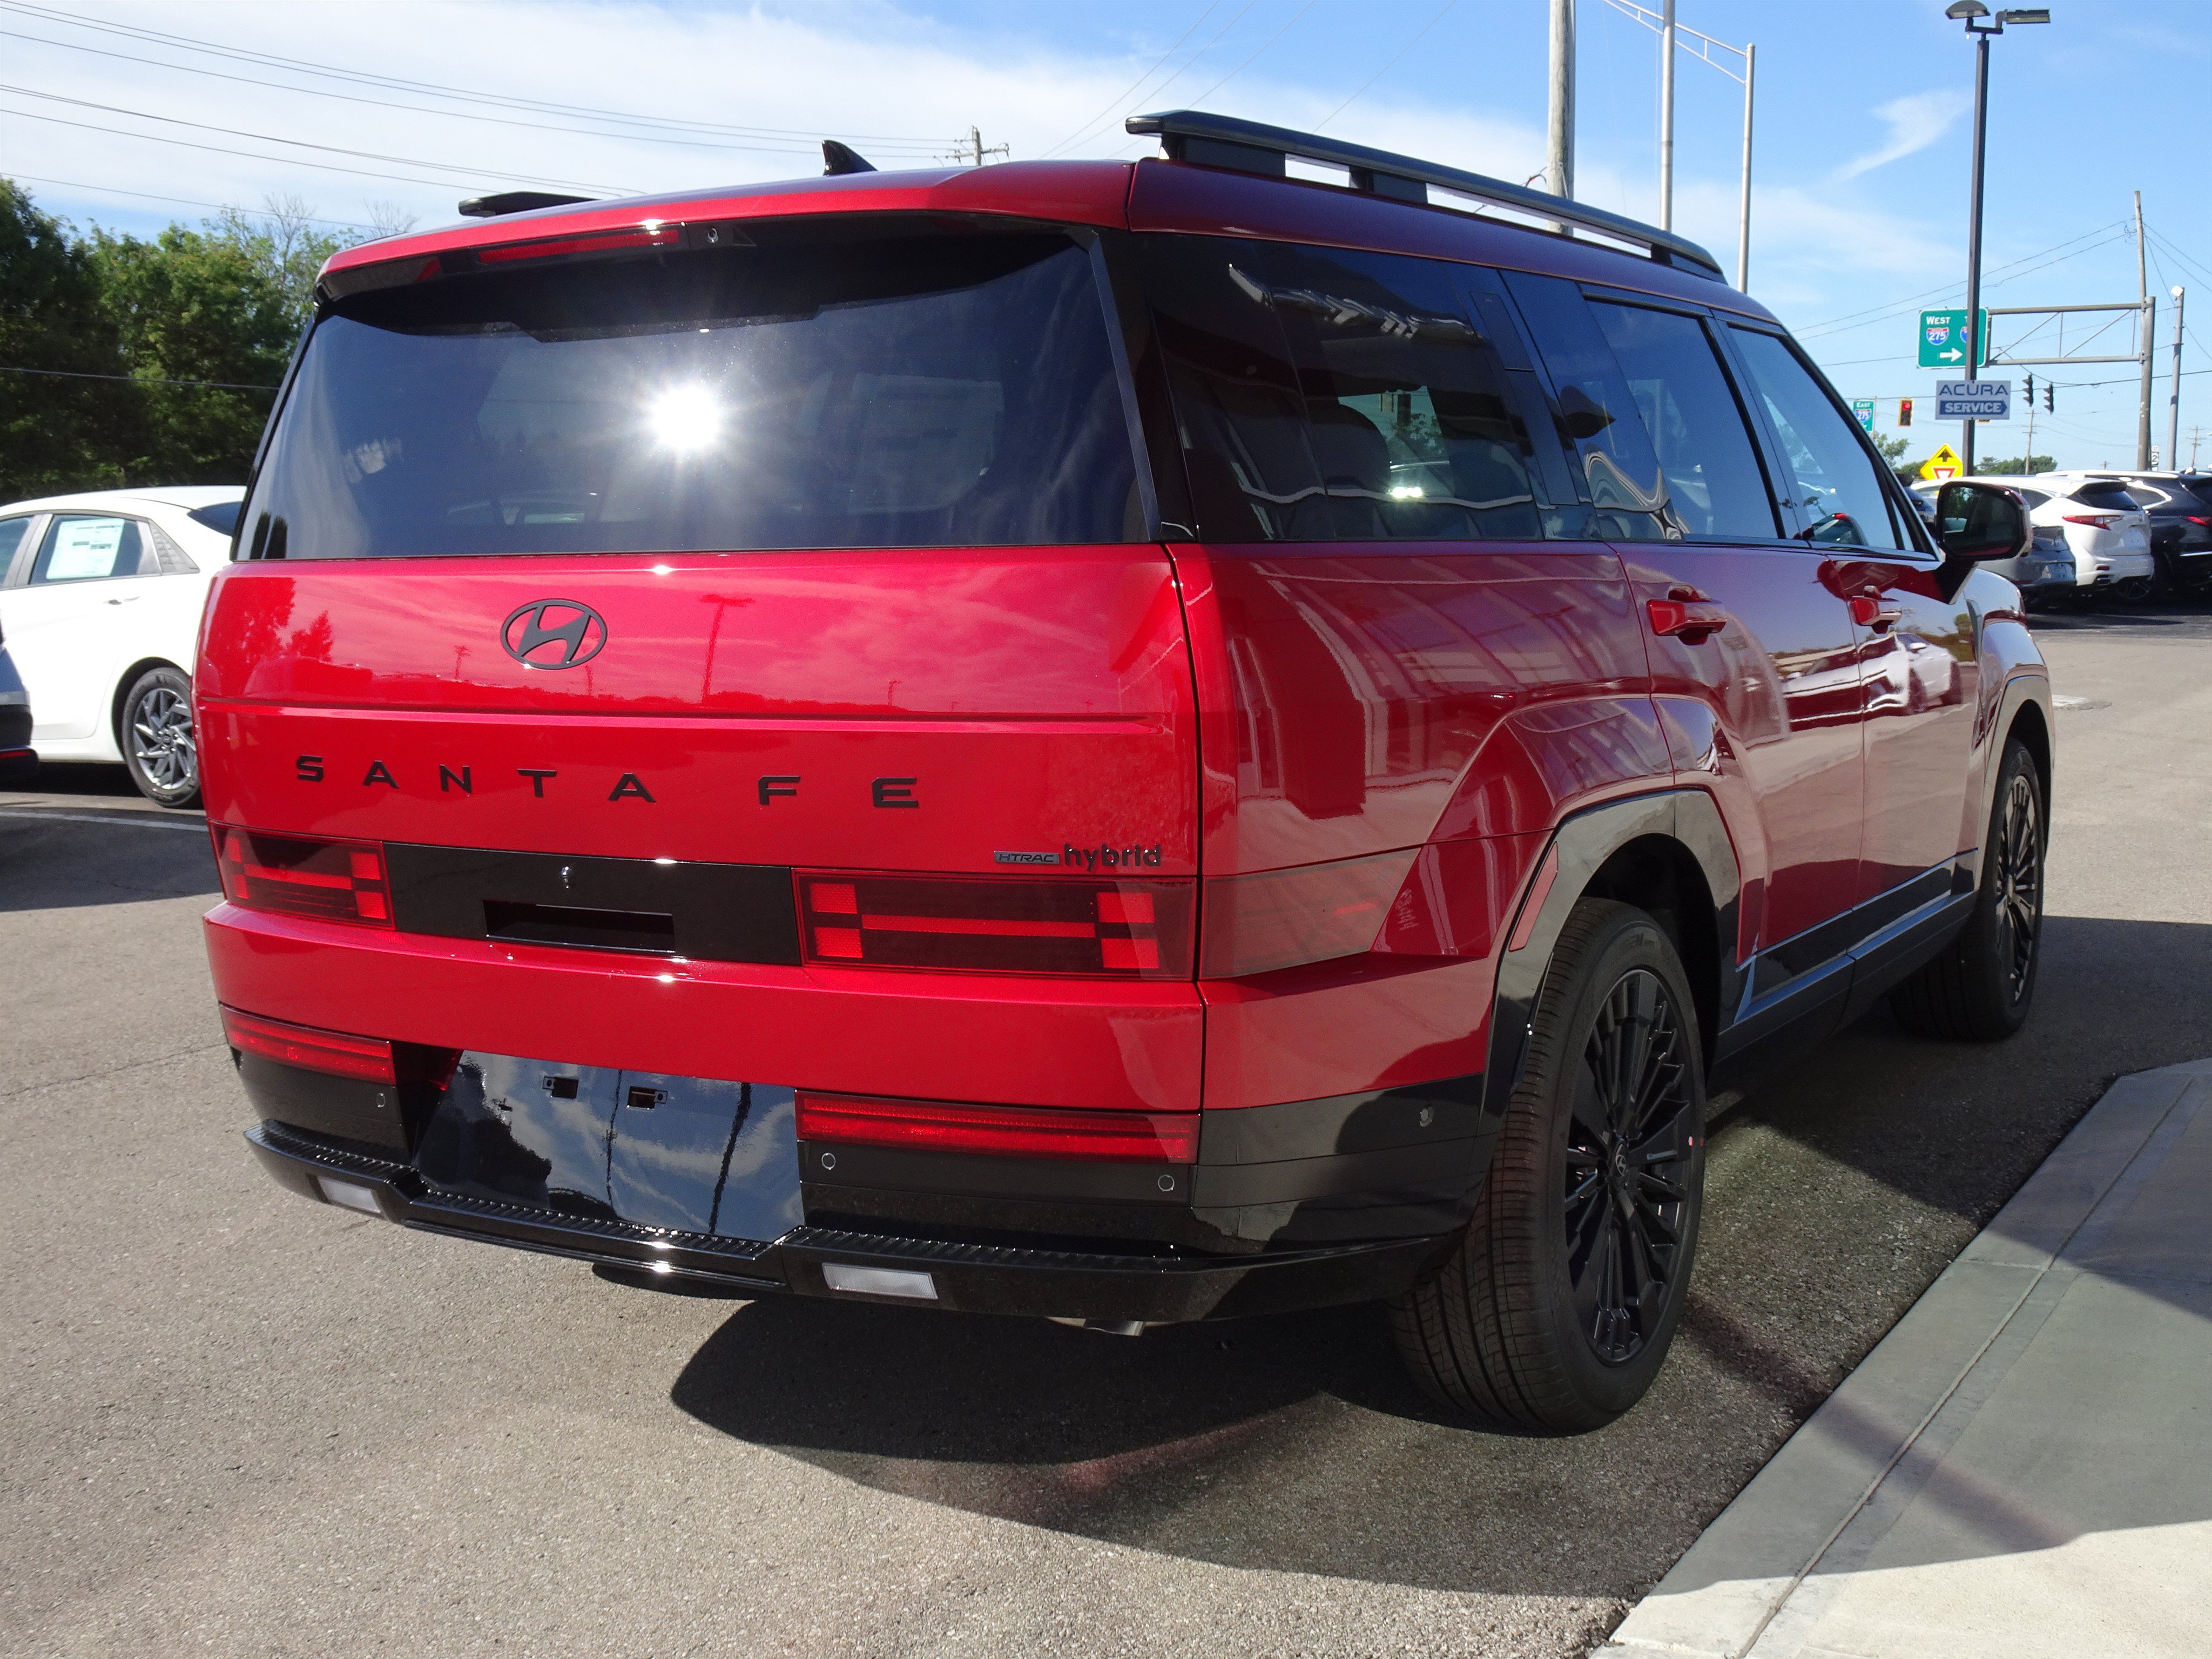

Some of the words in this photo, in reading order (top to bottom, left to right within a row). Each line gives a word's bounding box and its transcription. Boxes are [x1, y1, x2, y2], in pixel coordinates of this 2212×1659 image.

[1926, 316, 1951, 324] WEST
[1928, 332, 1946, 341] 275
[1939, 384, 2008, 395] ACURA
[1945, 402, 2001, 413] SERVICE
[296, 755, 656, 803] SANTA
[758, 776, 919, 808] FE
[999, 854, 1054, 862] HTRAC
[1064, 843, 1161, 871] hybrid
